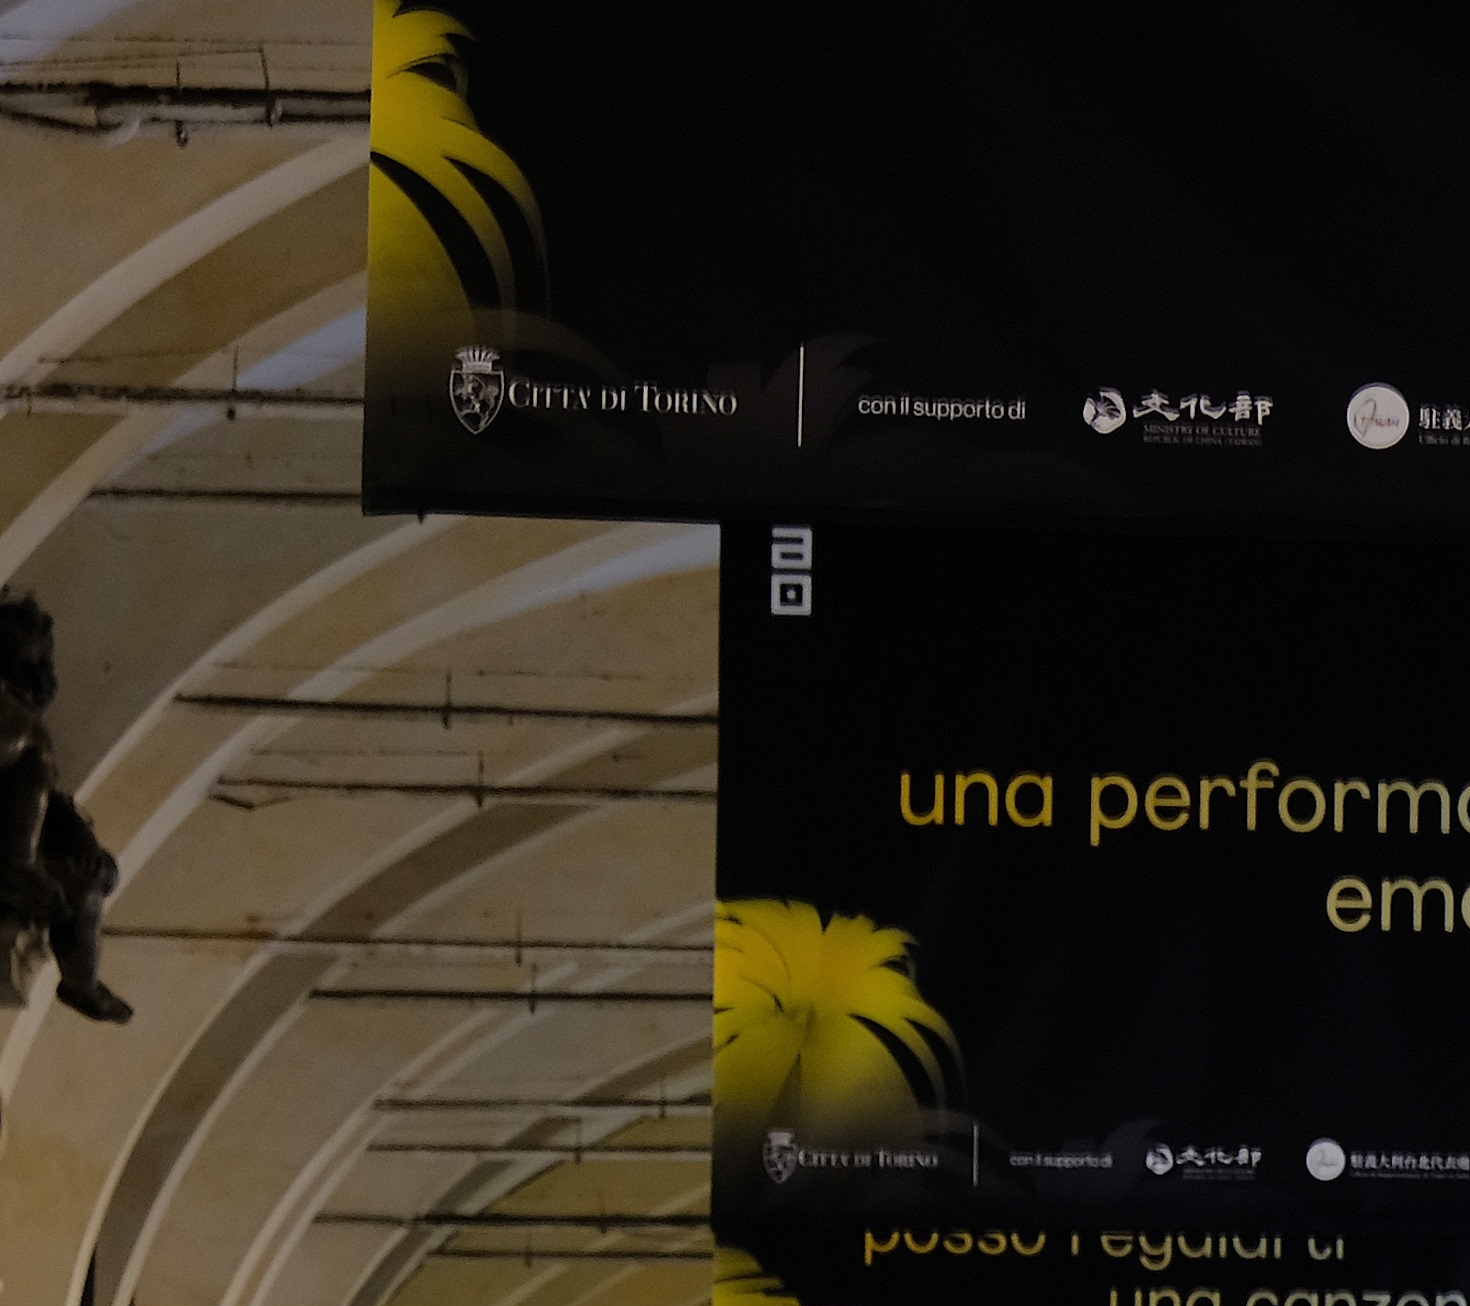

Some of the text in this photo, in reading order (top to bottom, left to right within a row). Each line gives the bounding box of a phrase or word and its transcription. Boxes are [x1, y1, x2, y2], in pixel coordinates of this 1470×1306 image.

[601, 386, 627, 412] DI
[635, 381, 738, 416] TORINO
[858, 396, 1026, 421] con il supporto di
[1132, 390, 1274, 425] 文化部
[898, 766, 1054, 827] una
